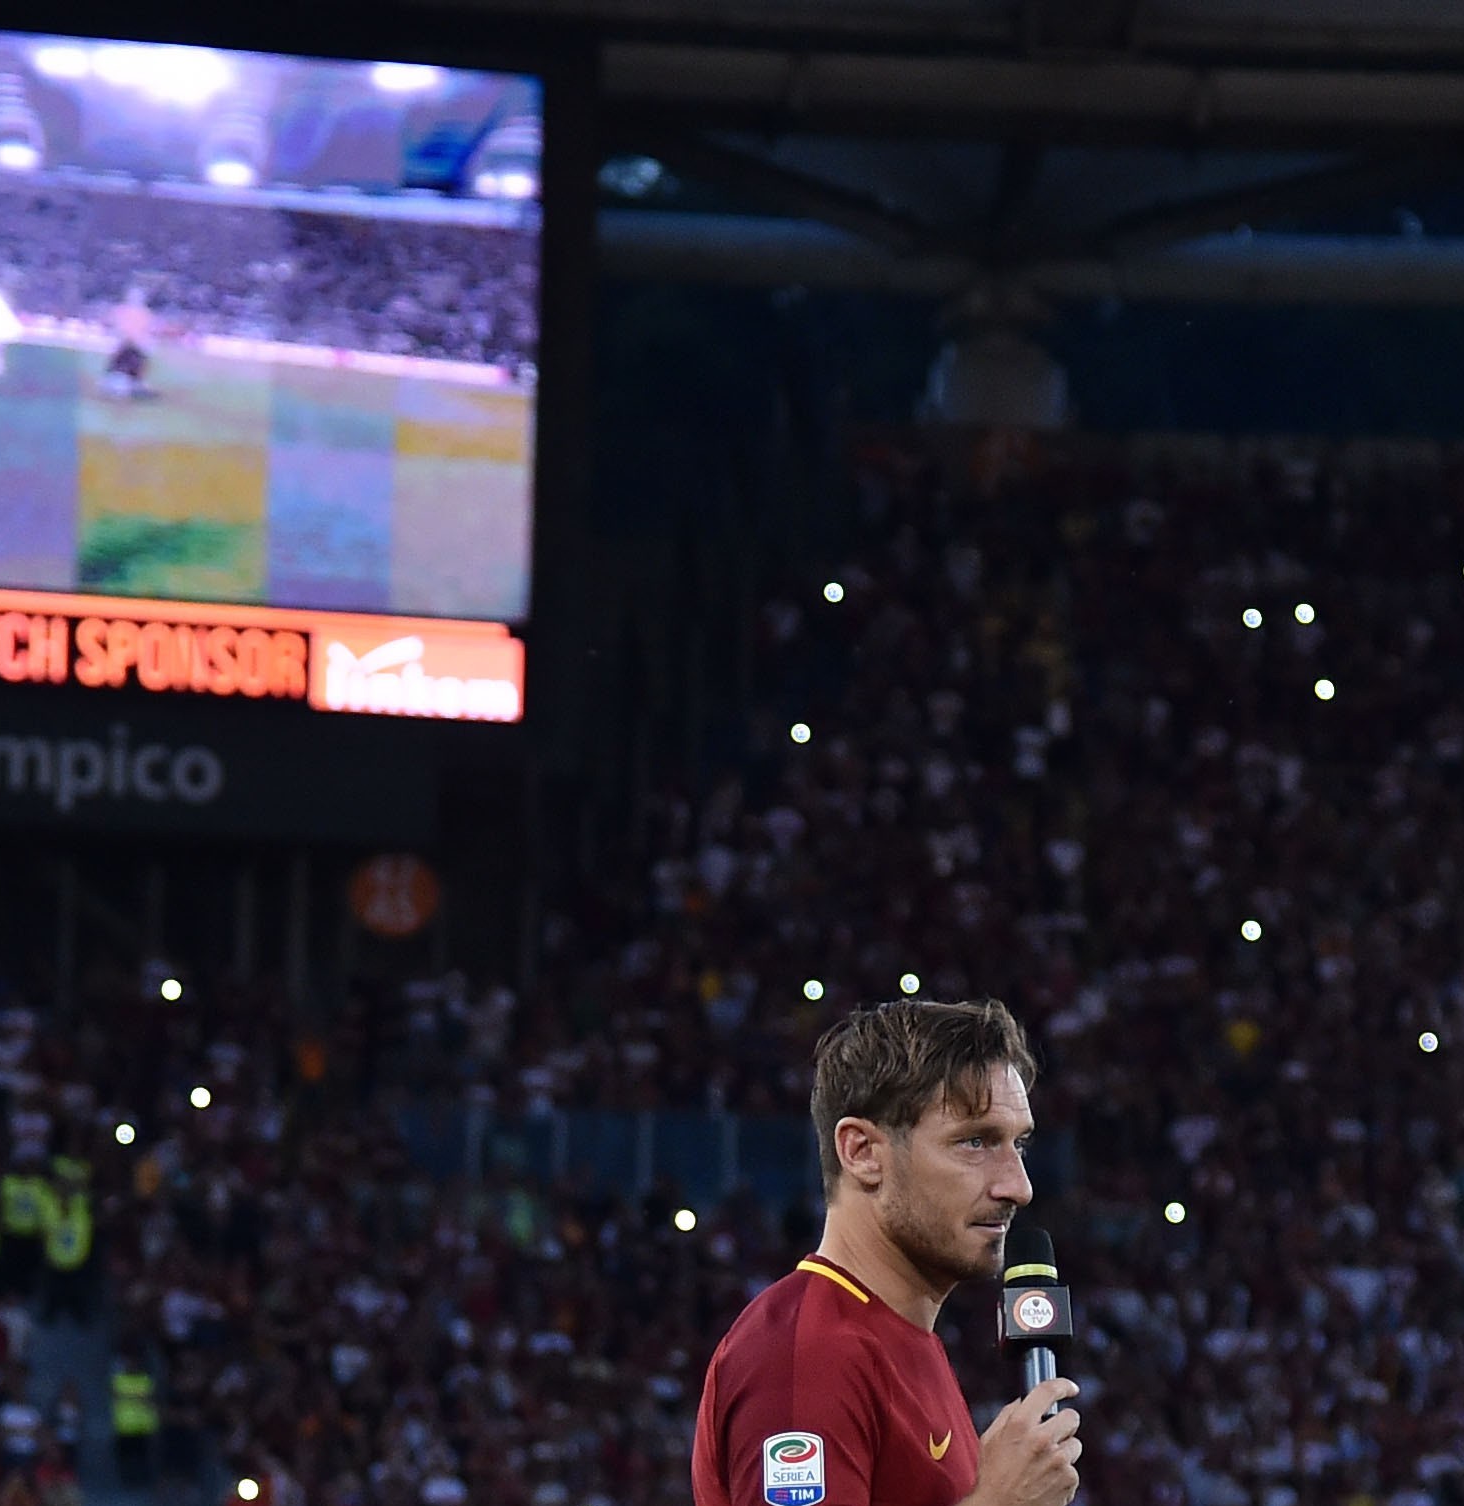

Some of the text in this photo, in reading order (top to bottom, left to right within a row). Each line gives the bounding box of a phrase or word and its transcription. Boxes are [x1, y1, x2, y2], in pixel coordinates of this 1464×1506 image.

[75, 617, 308, 700] SPONSOR
[1022, 1307, 1052, 1317] ROMA
[772, 1470, 815, 1483] SERIE A
[789, 1488, 815, 1501] TIM
